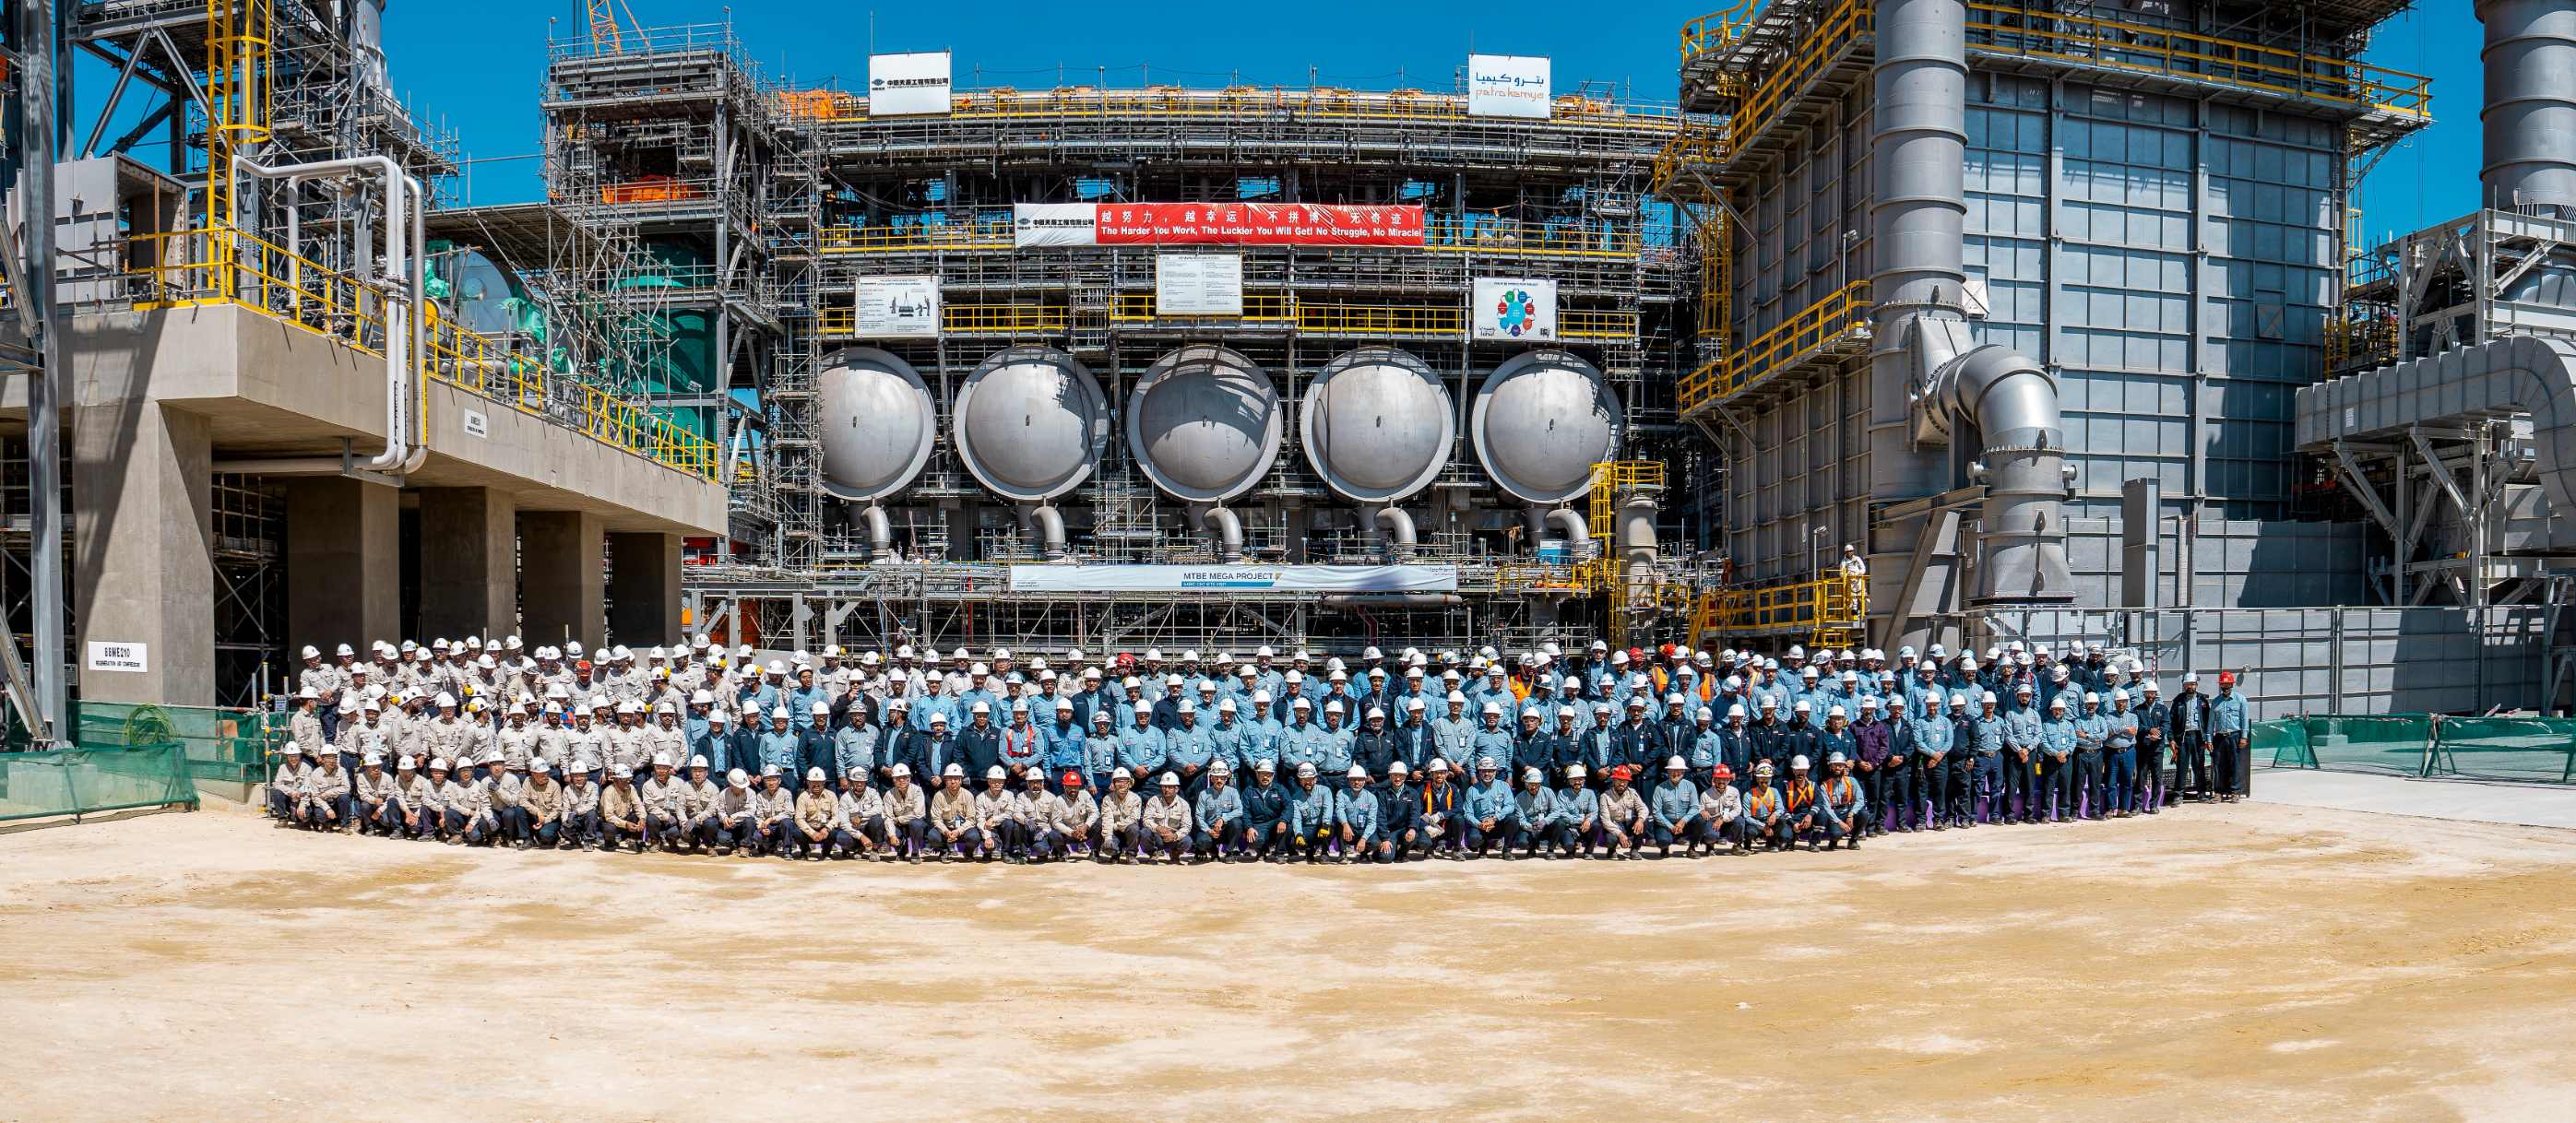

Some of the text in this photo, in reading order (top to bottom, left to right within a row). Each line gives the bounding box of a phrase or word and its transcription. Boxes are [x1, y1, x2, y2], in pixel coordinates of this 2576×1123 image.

[1101, 226, 1118, 235] The
[1121, 226, 1151, 235] Harder
[1154, 226, 1169, 234] You
[1172, 225, 1198, 237] Work,
[1201, 225, 1217, 234] The
[1221, 225, 1253, 235] Luckier
[1256, 226, 1273, 235] You
[1276, 226, 1292, 235] Will
[1316, 227, 1328, 235] No
[1331, 227, 1371, 238] Struggle,
[1372, 228, 1385, 236] No
